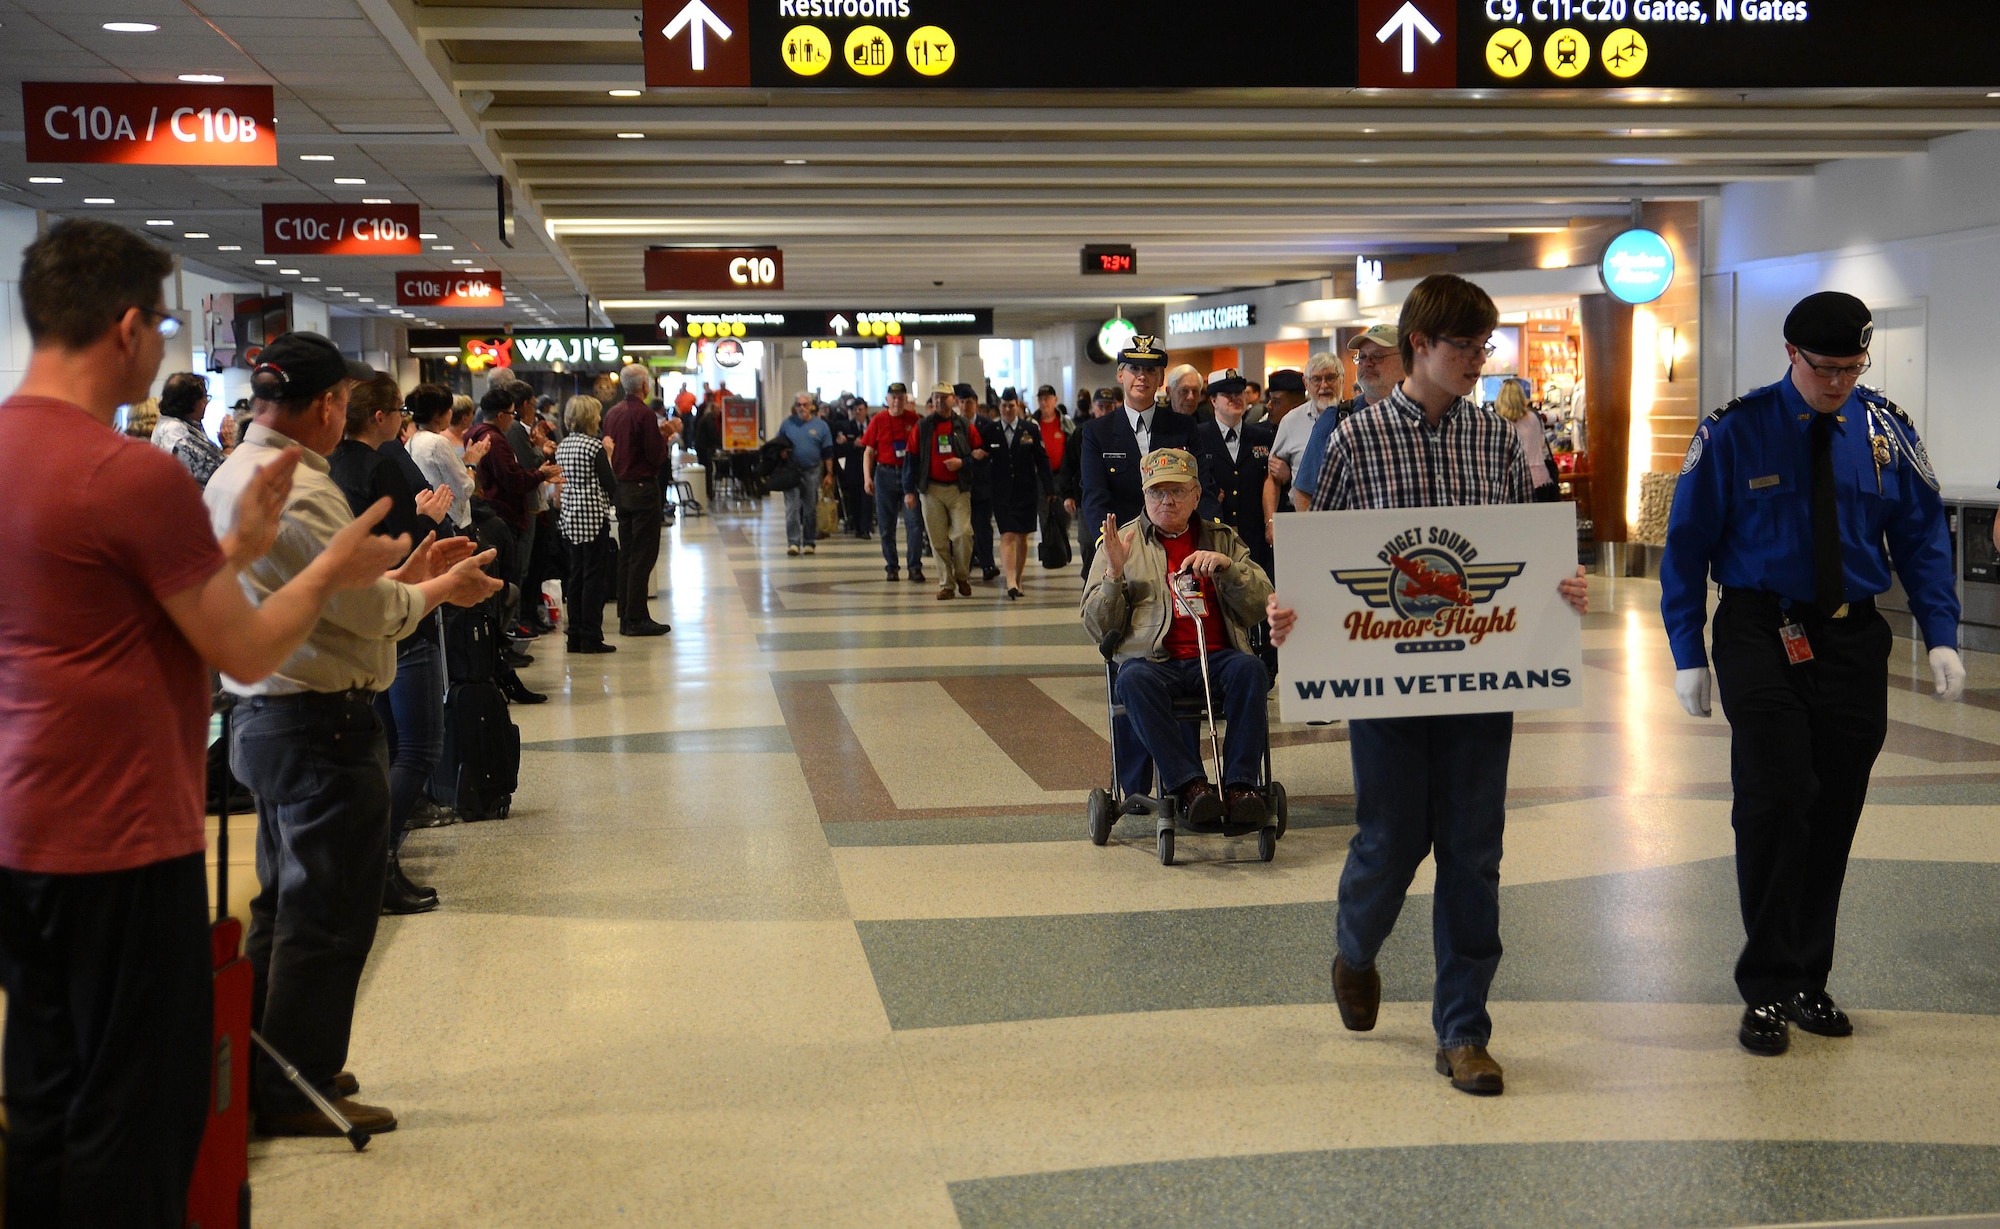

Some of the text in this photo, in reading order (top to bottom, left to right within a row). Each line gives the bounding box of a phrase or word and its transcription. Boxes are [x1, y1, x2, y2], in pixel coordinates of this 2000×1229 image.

[779, 0, 910, 17] Restrooms
[1486, 0, 1807, 24] C9, C11-C20 Gates, N Gates
[45, 106, 258, 143] C10A / C10B
[275, 218, 409, 241] C10C / C10D
[728, 256, 775, 285] C10
[1100, 255, 1130, 271] 7:34
[404, 280, 441, 297] C10E
[444, 281, 451, 296] /
[1168, 304, 1249, 335] STARBUCKS COFFEE
[515, 336, 619, 363] WAJI'S
[1377, 526, 1478, 565] PUGET SOUND
[1343, 606, 1517, 645] Honor Flight
[1295, 668, 1571, 700] WWII VETERANS
